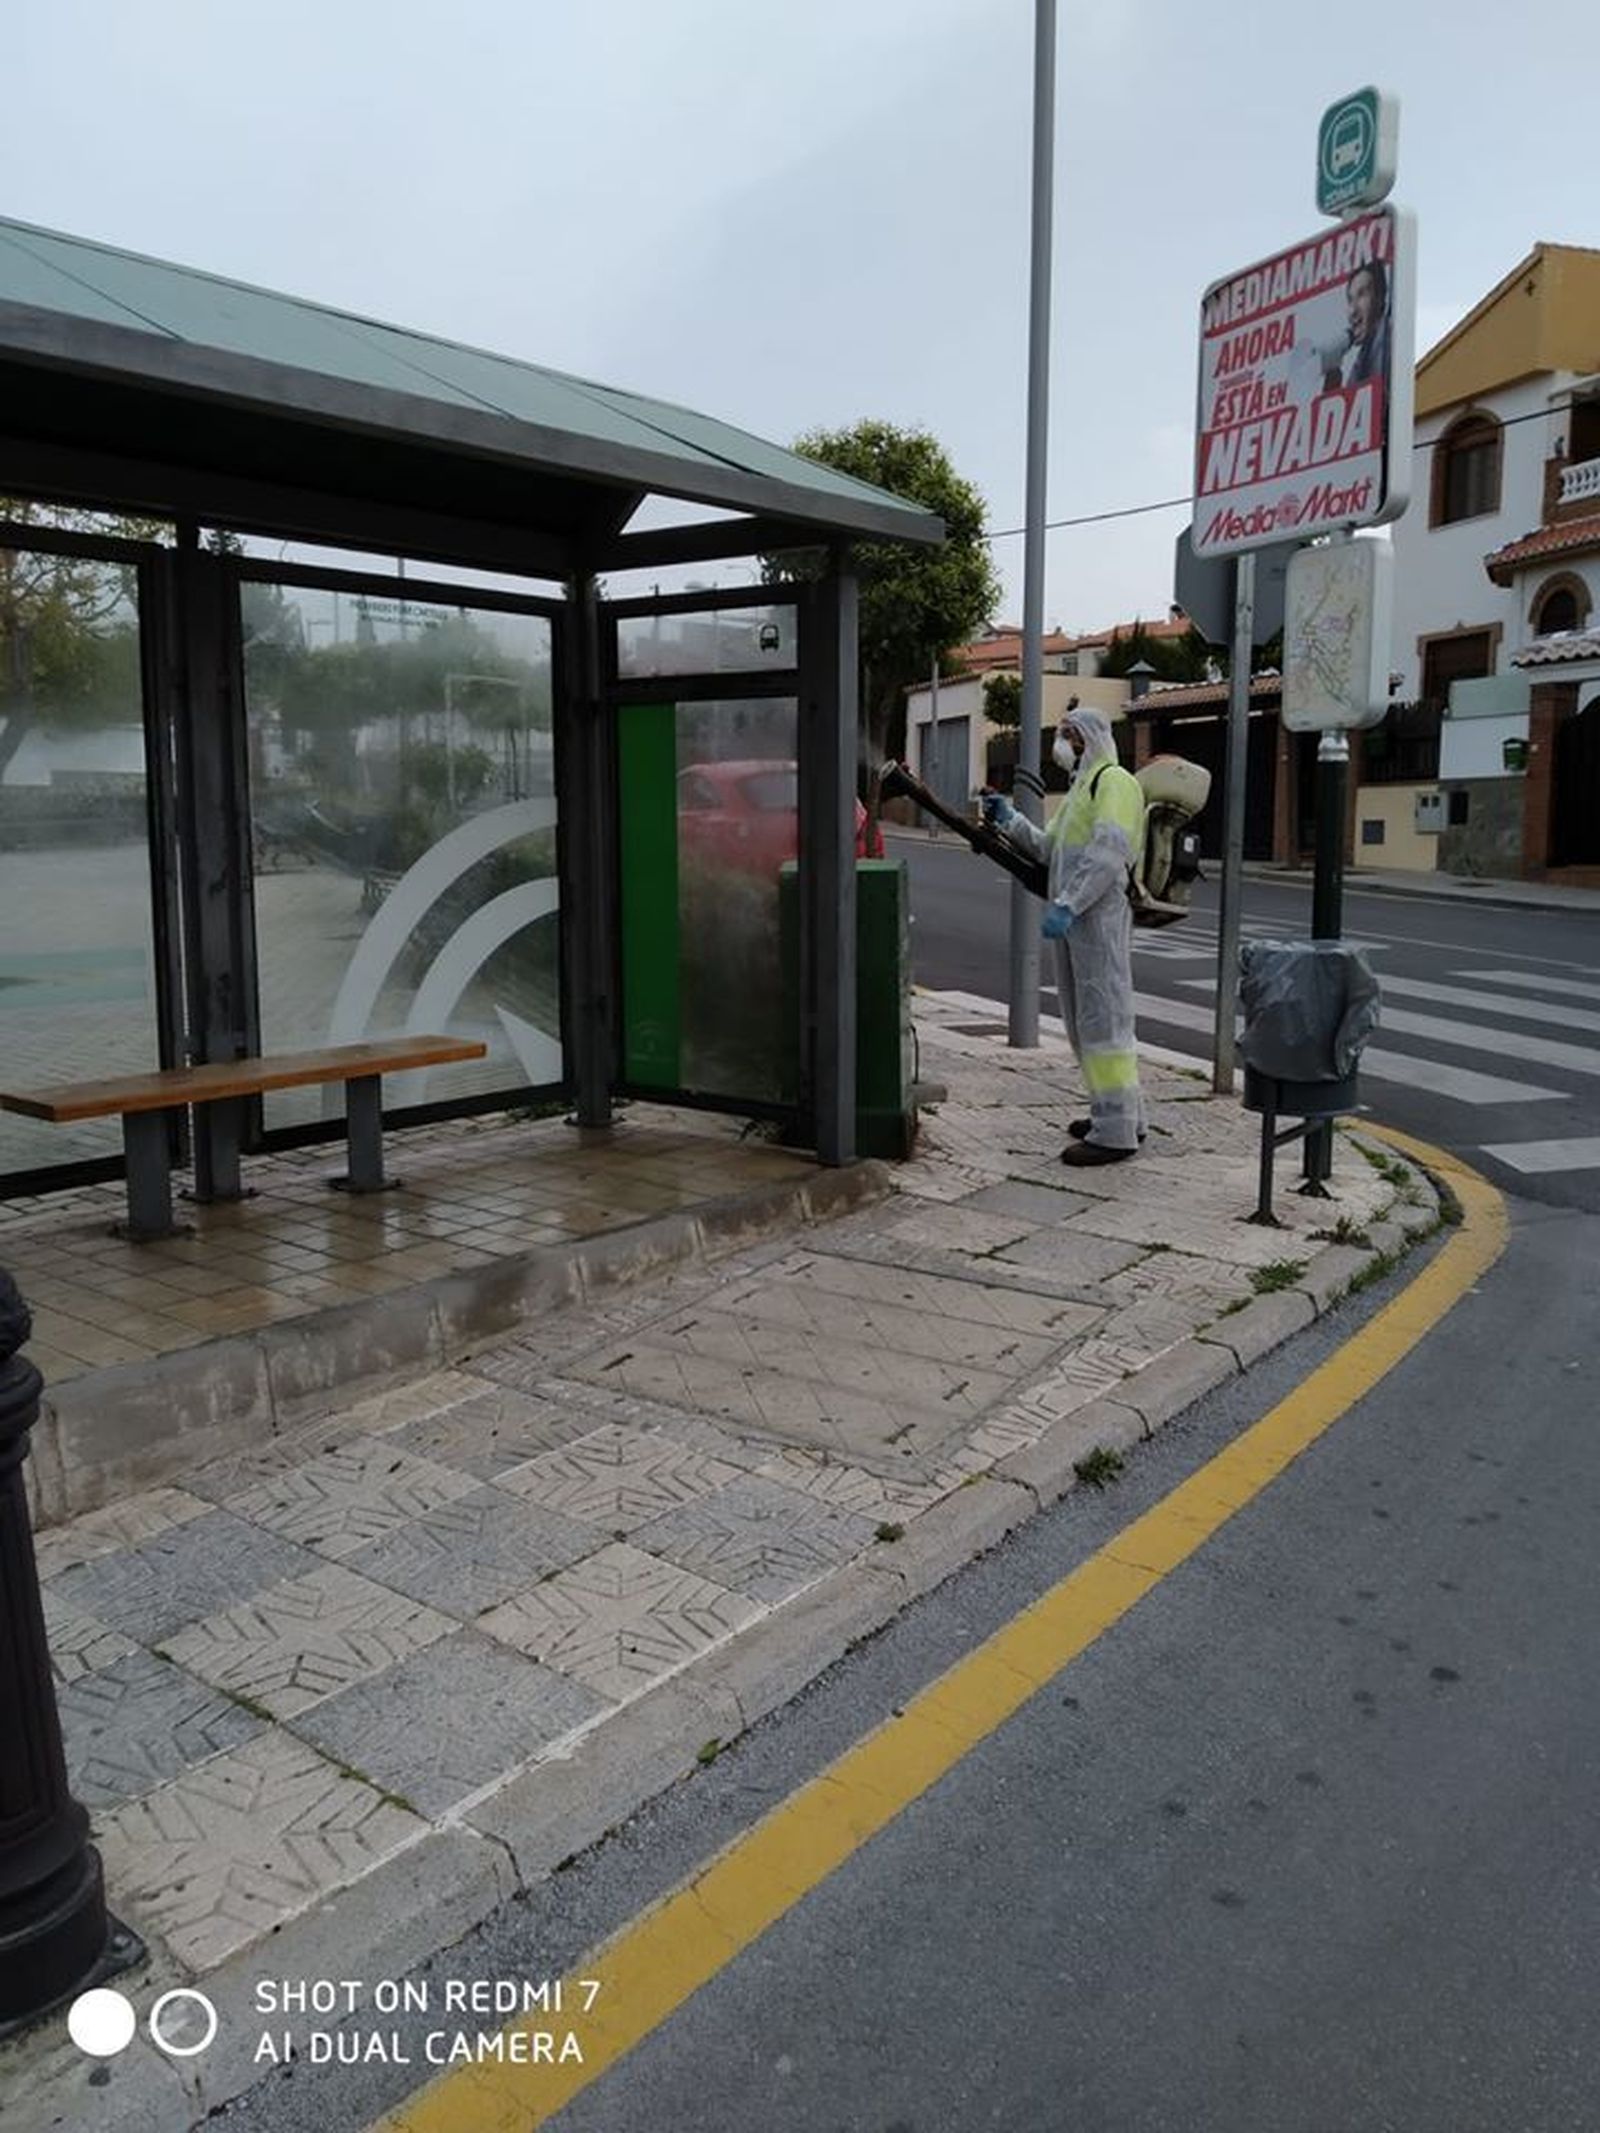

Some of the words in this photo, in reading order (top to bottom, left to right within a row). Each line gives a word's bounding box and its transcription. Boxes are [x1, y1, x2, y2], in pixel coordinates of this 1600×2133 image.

[1204, 216, 1391, 330] MEDIAMARKT
[1214, 314, 1295, 378] AHORA
[1212, 371, 1265, 428] ESTÁ
[1266, 381, 1288, 408] EN
[1203, 384, 1372, 492] NEVADA
[1200, 505, 1277, 546] Media
[1295, 477, 1372, 524] Markt
